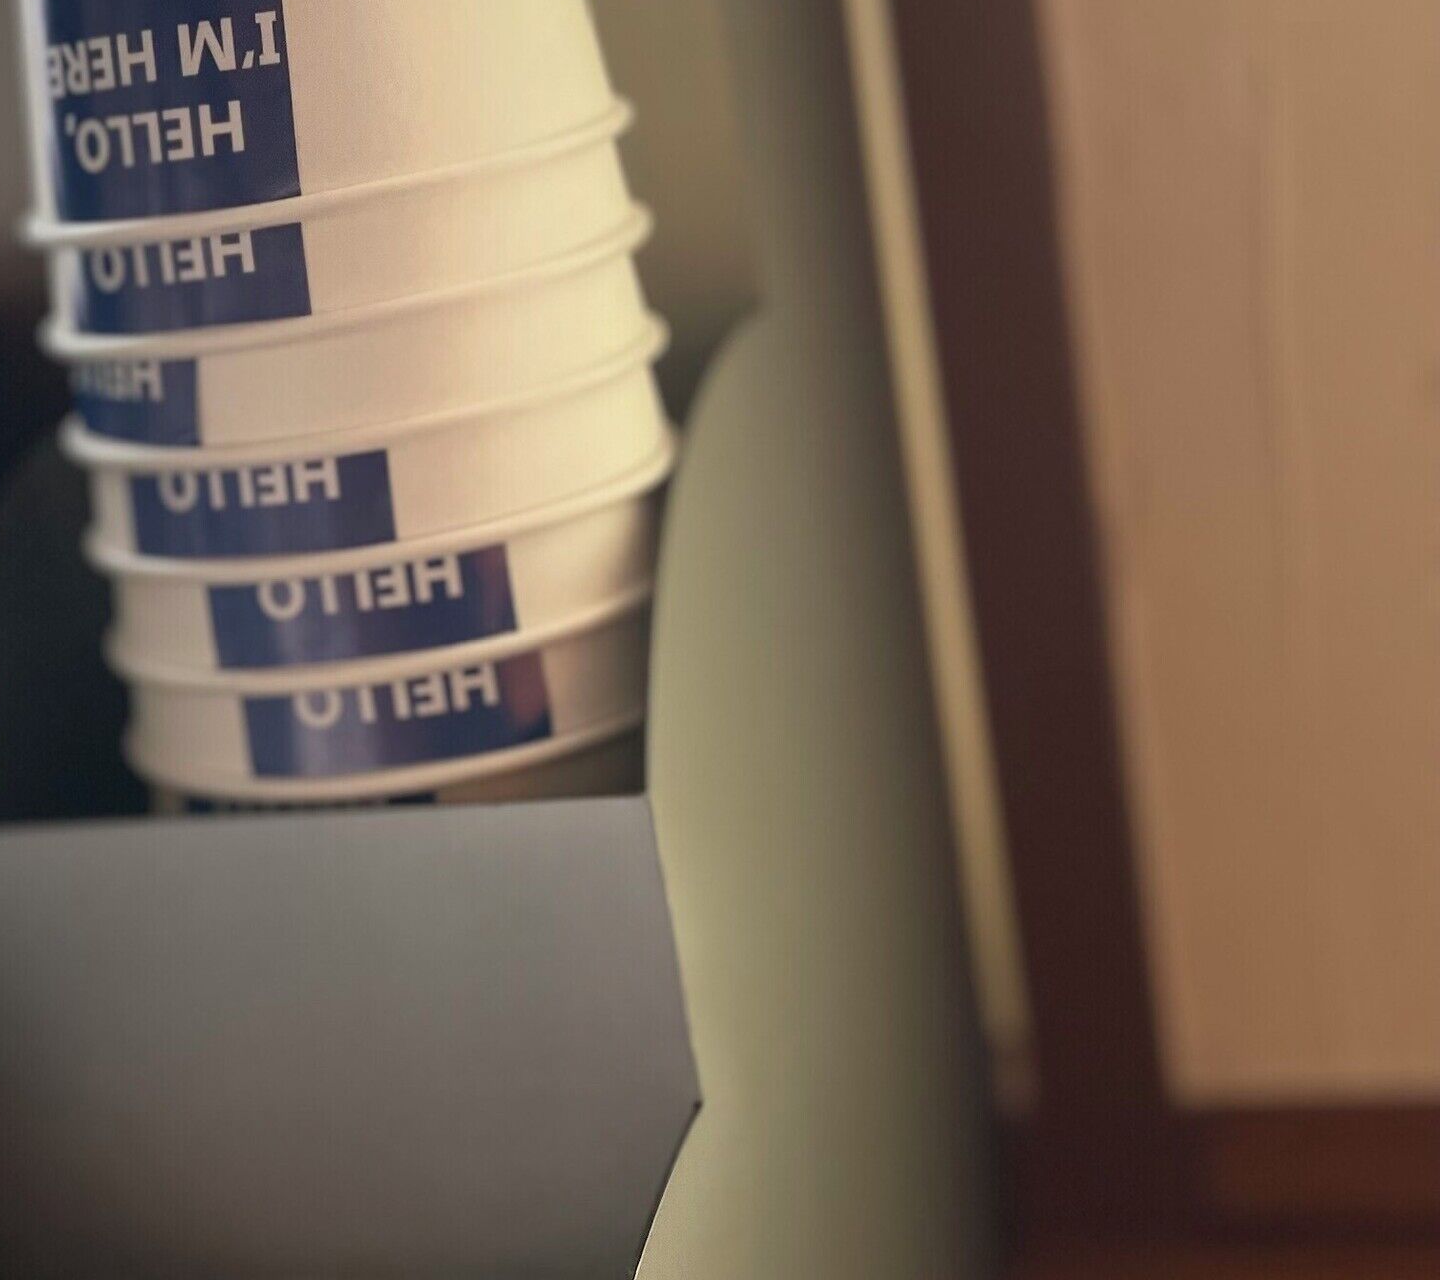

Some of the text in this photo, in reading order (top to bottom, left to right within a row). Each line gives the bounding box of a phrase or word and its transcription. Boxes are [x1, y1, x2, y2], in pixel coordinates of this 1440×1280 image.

[45, 10, 280, 99] I'M HERE
[64, 100, 244, 174] HELLO,
